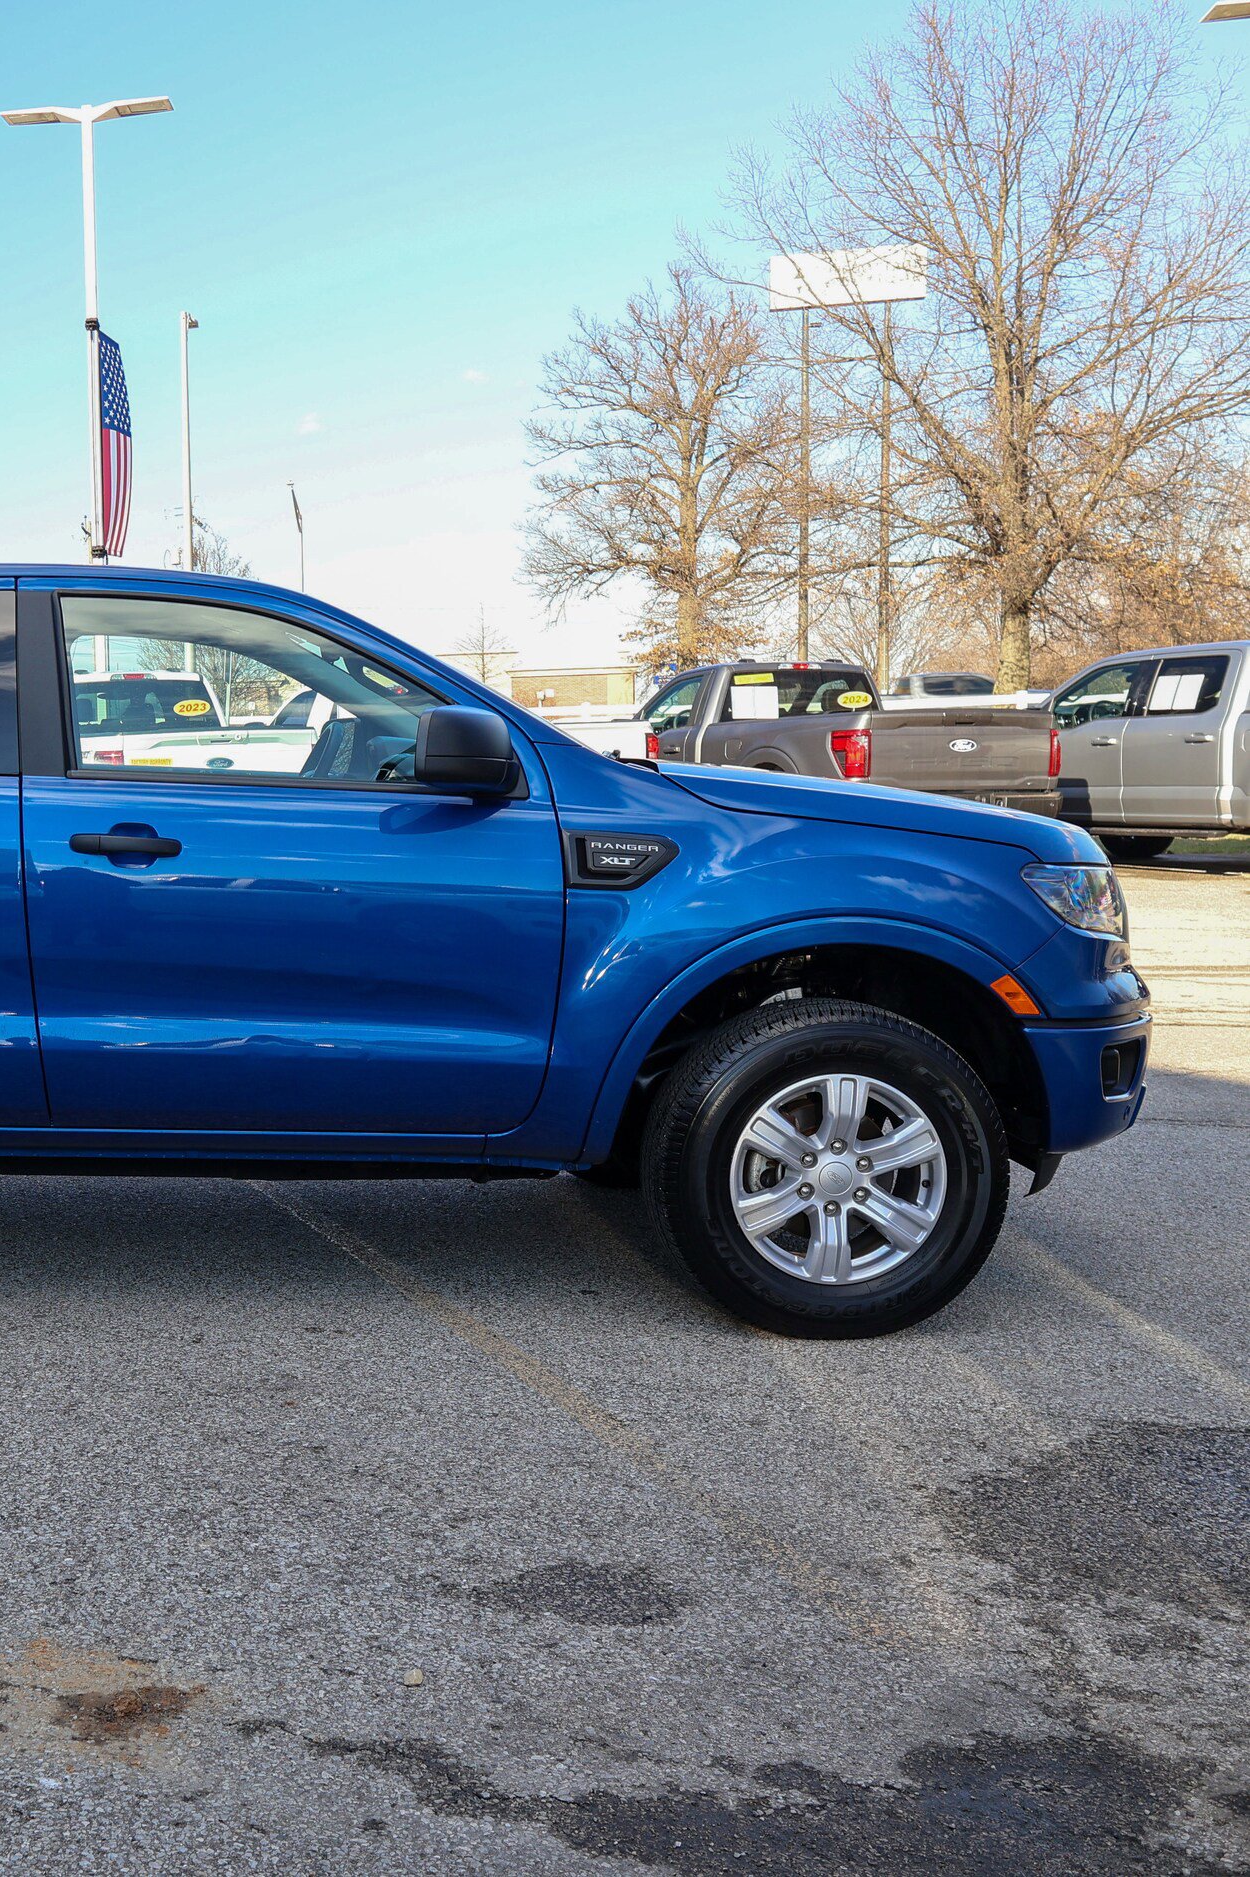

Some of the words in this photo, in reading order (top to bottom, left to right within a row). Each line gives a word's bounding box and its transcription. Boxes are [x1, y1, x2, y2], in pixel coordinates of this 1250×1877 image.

[842, 696, 868, 705] 2024
[178, 702, 207, 713] 2023
[591, 841, 659, 852] RANGER
[600, 856, 636, 866] XLT
